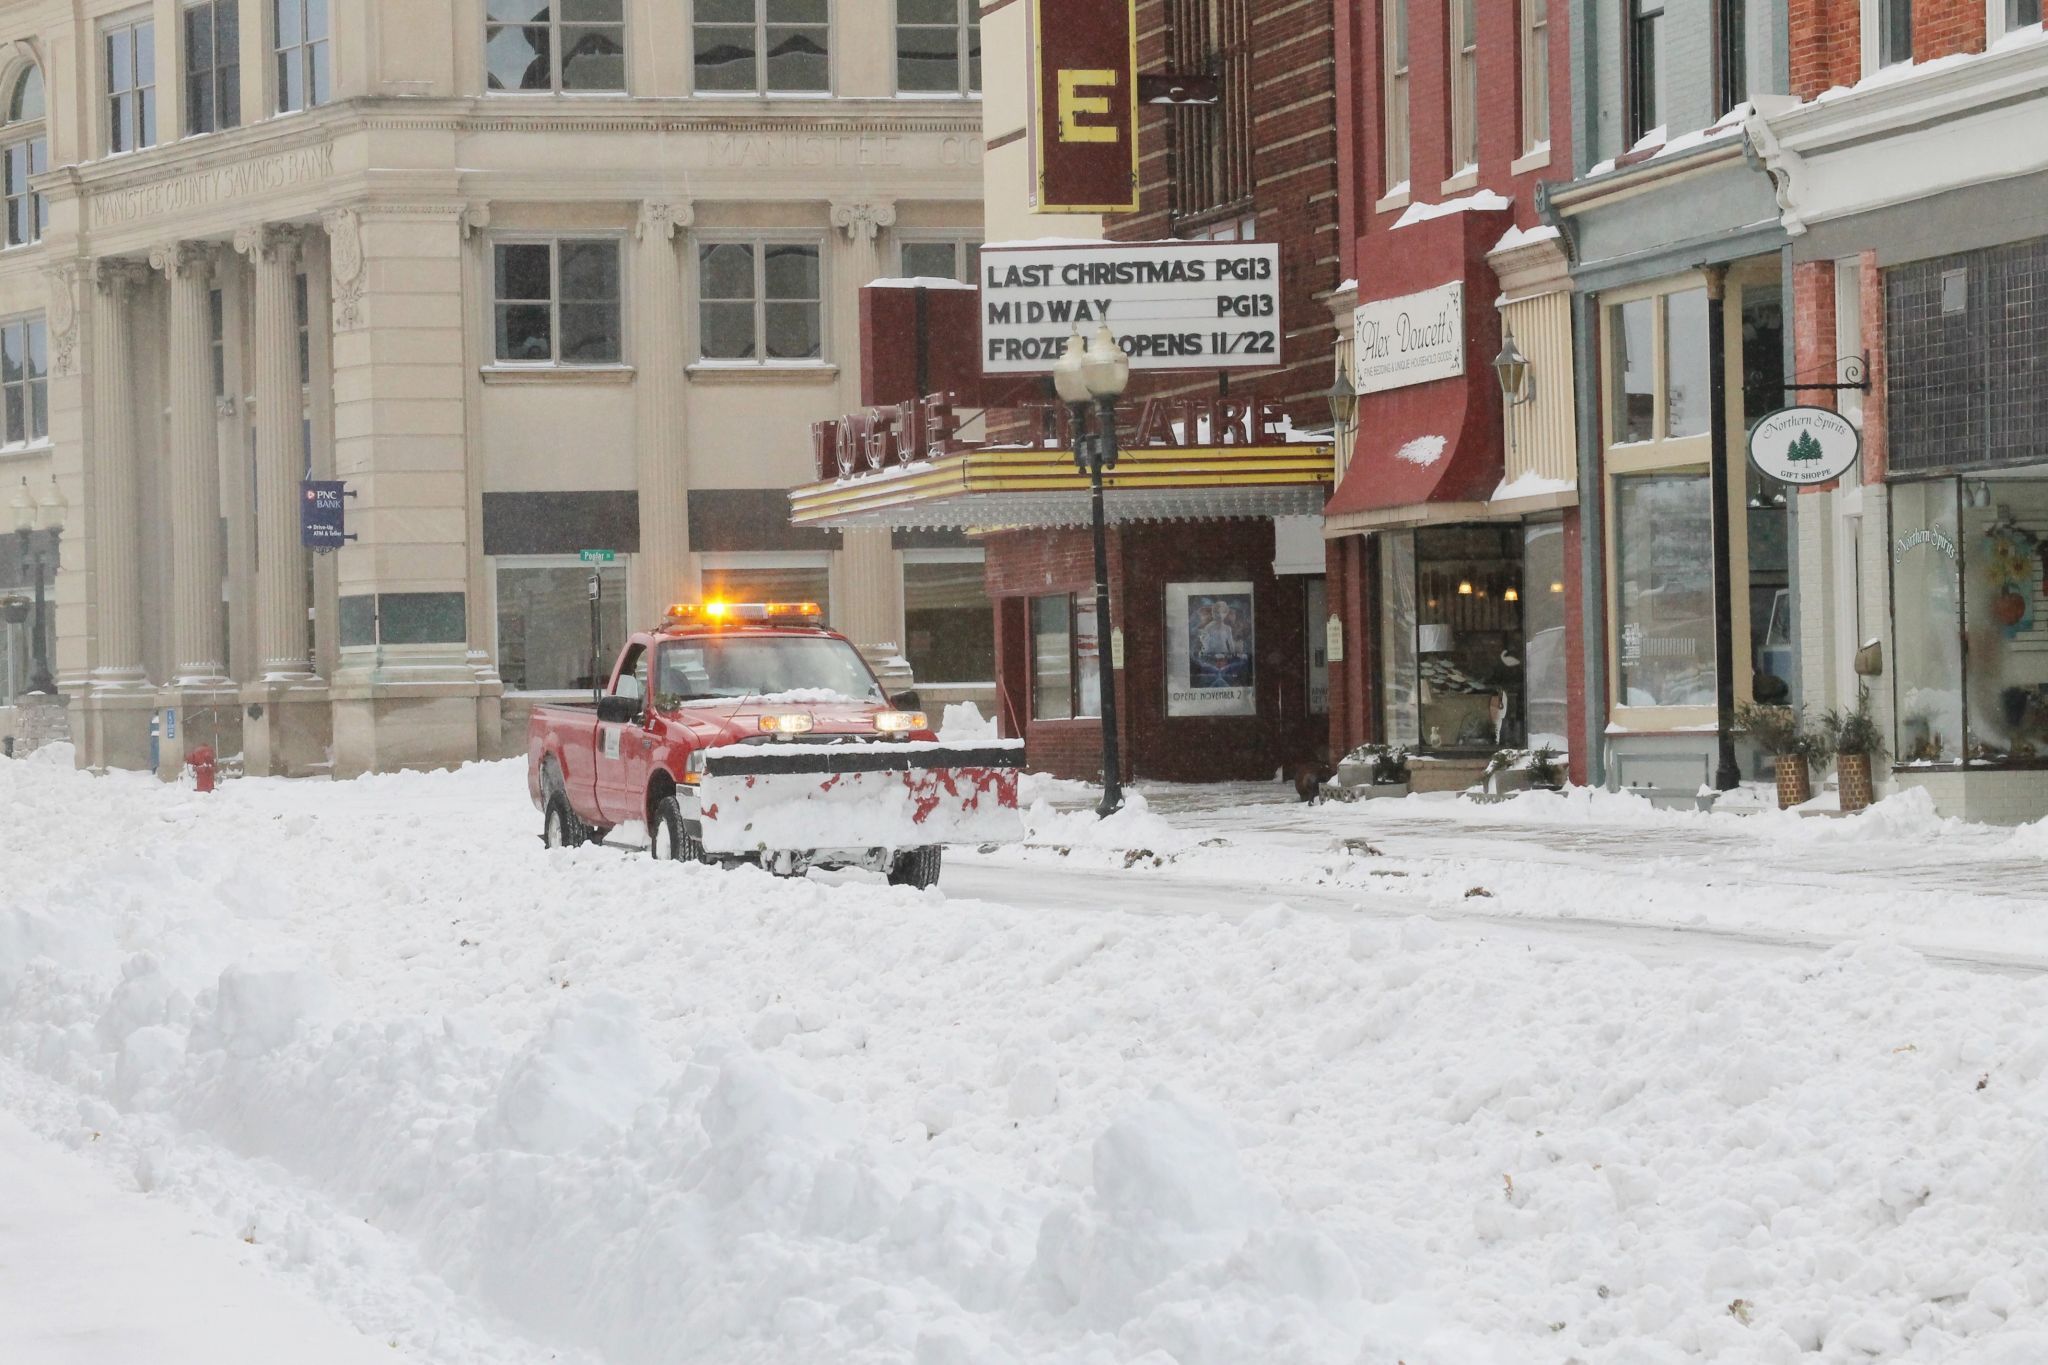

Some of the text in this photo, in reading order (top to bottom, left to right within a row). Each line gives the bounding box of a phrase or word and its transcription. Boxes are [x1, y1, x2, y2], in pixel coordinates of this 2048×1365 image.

[1058, 69, 1119, 143] E
[706, 135, 901, 167] MANISTEE
[94, 143, 334, 226] MANISTEE COUNTY SAVINGS BANK
[987, 264, 1053, 289] LAST
[1062, 259, 1206, 286] CHRISTMAS
[988, 298, 1112, 325] MIDWAY
[1118, 333, 1203, 357] OPENS
[1361, 302, 1454, 362] Alex Doucett's
[1394, 358, 1410, 371] UNIQUE
[1411, 353, 1437, 368] HOUSEHOLD
[1437, 350, 1453, 363] GOODS
[1763, 413, 1847, 439] Northern Spirits
[1780, 468, 1832, 479] GIFT SHOPPE
[316, 500, 341, 509] BANK
[317, 490, 337, 499] PNC
[584, 551, 605, 560] Poplar
[1896, 524, 1956, 564] Northern Spirits
[1173, 692, 1197, 701] OPENS
[1200, 691, 1235, 701] NOVEMBER
